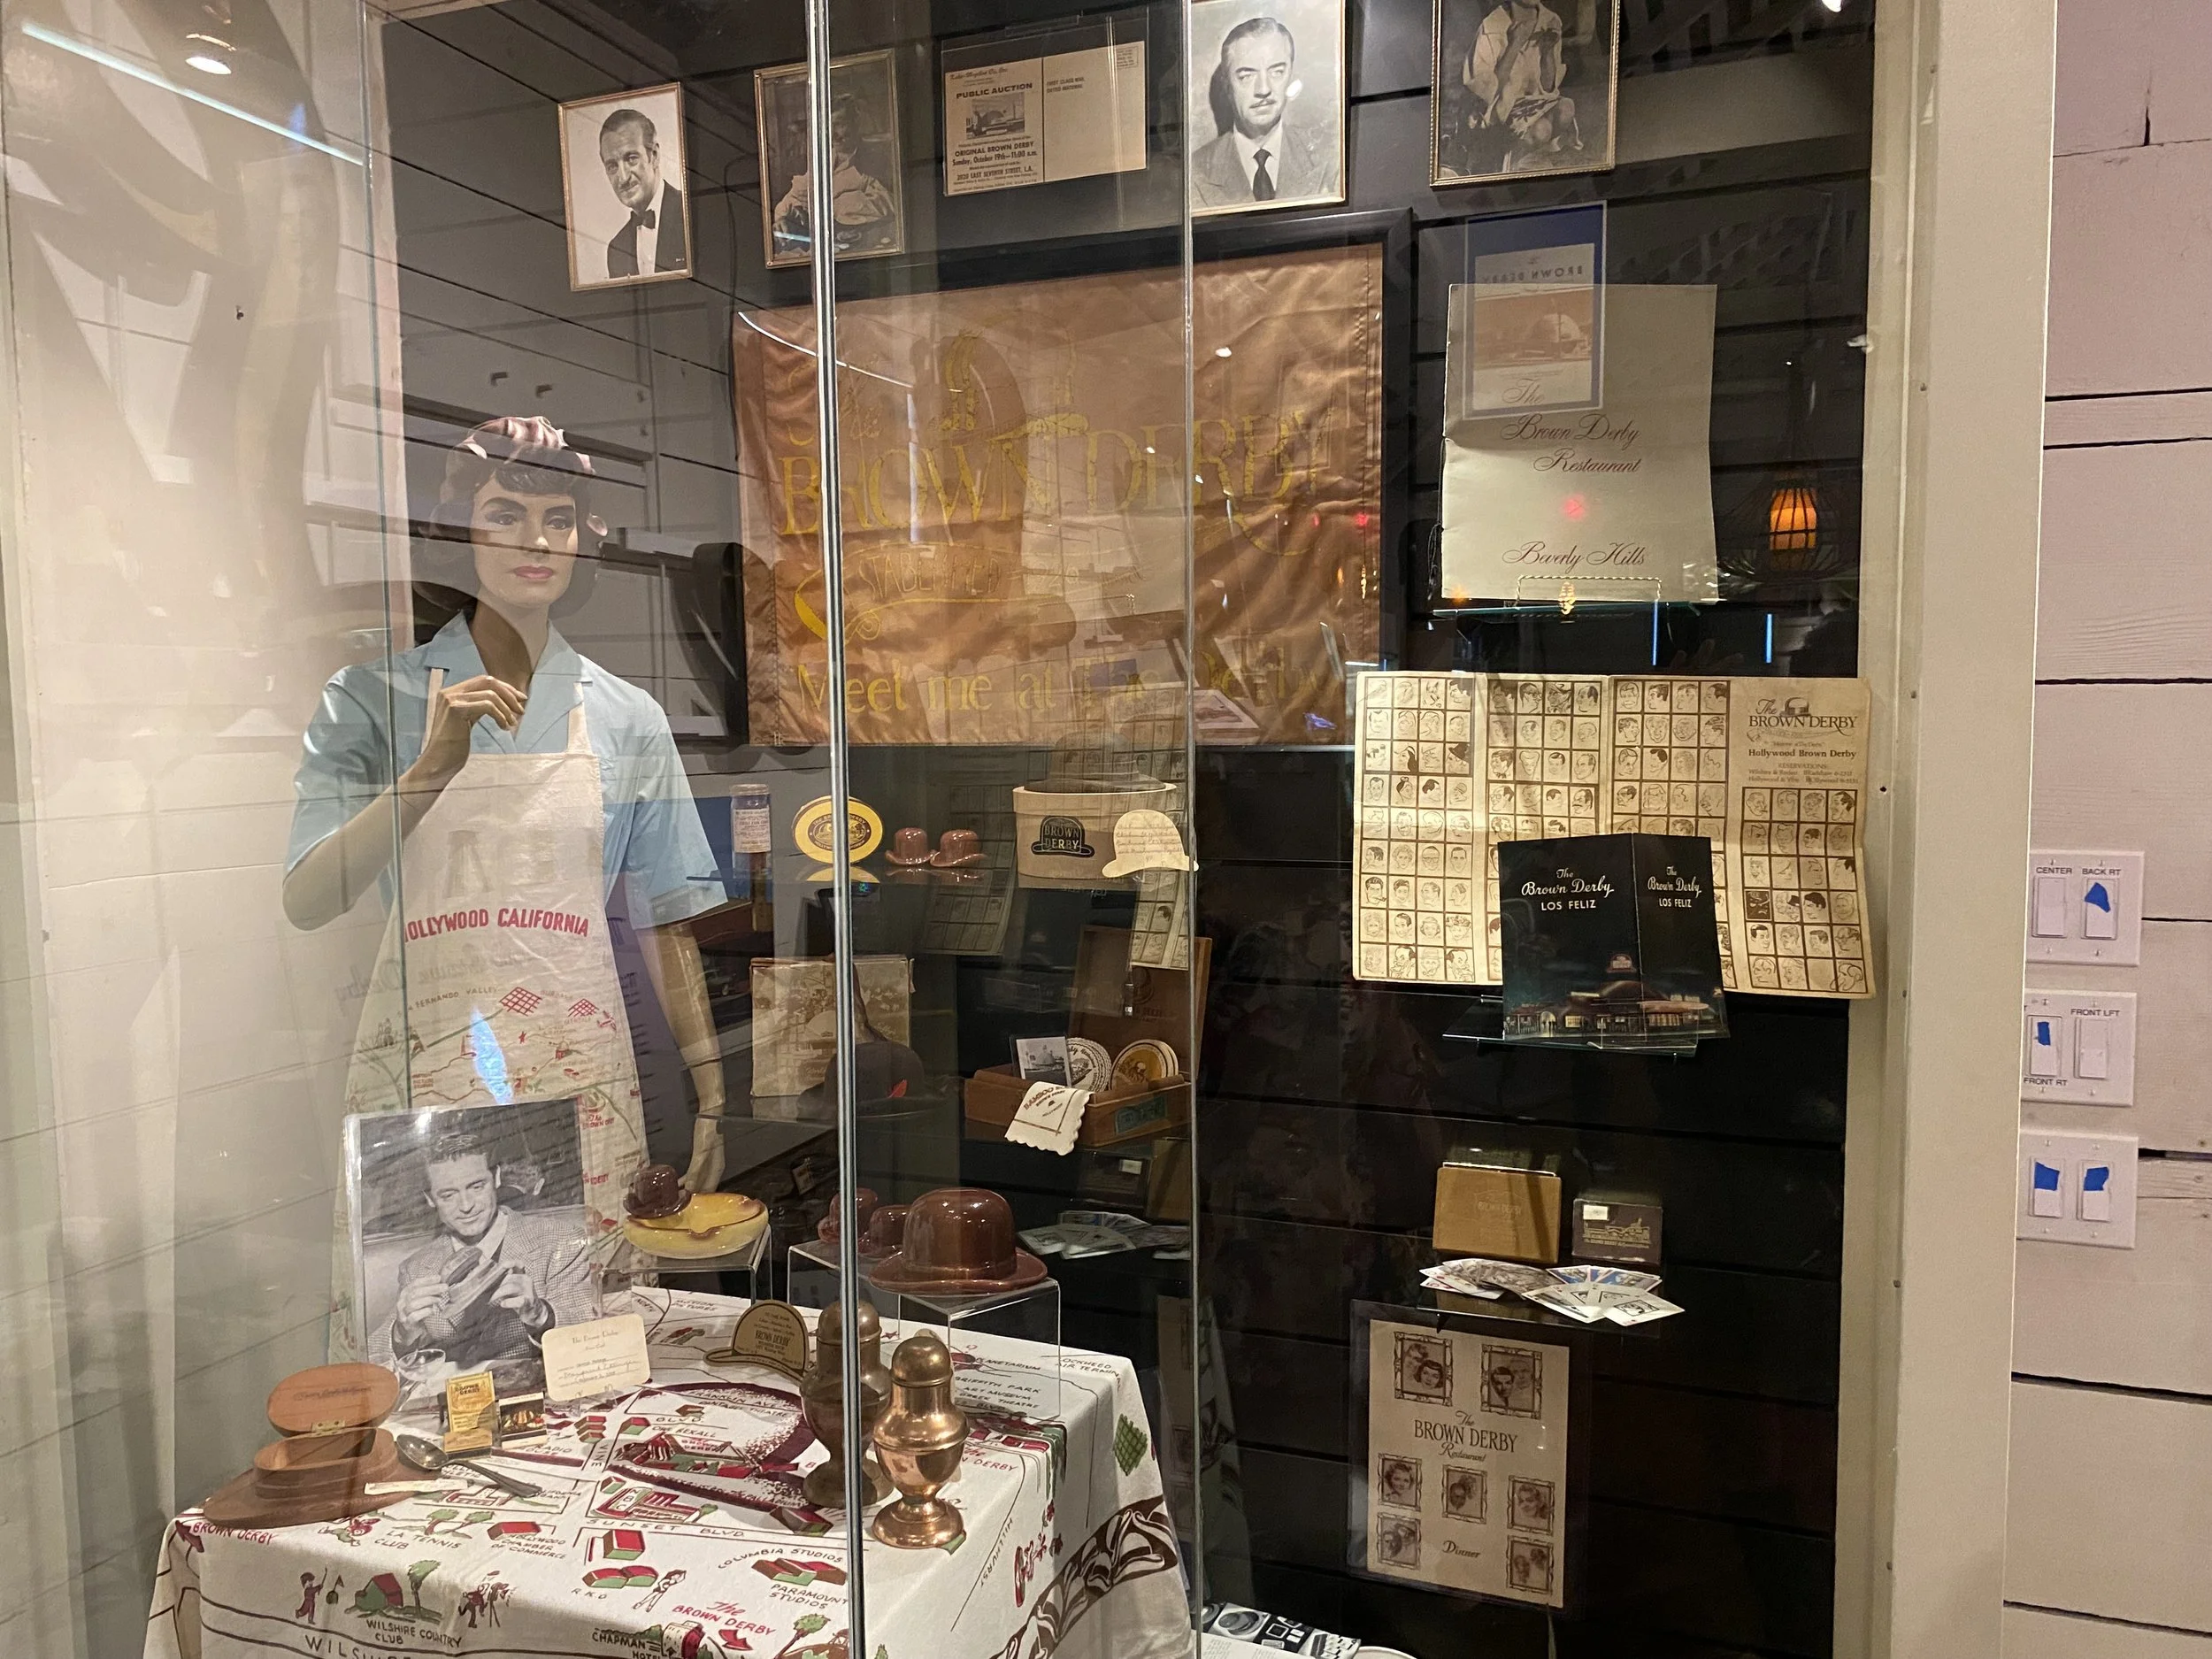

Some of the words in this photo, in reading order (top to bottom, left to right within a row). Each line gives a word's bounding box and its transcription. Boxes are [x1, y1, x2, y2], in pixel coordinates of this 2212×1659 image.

[956, 88, 989, 99] PUBLIC
[991, 82, 1033, 94] AUCTION
[955, 148, 986, 157] ORIGINAL
[987, 144, 1012, 153] BROWN
[1503, 379, 1544, 405] The
[1501, 413, 1571, 441] Brown
[1571, 413, 1640, 449] Derby
[1533, 448, 1642, 473] Restaurant
[1502, 541, 1585, 574] Beverly
[1586, 541, 1646, 566] Hills
[927, 673, 992, 711] me
[1018, 662, 1056, 711] at
[1755, 698, 1778, 715] The
[1748, 715, 1805, 727] BROWN
[1809, 716, 1858, 731] DERBY
[1748, 749, 1795, 759] Hollywood
[1830, 749, 1856, 760] Derby
[1044, 825, 1079, 839] BROWN
[1045, 838, 1079, 850] DERBY
[1555, 868, 1574, 879] The
[1666, 865, 1678, 876] The
[1521, 881, 1568, 896] Brown
[1571, 875, 1615, 898] Derby
[1647, 876, 1674, 891] Brown
[1675, 876, 1702, 898] Derby
[1540, 900, 1563, 911] LOS
[1568, 900, 1597, 910] FELIZ
[1658, 898, 1672, 908] LOS
[1674, 899, 1692, 908] FELIZ
[497, 908, 589, 938] CALIFORNIA
[415, 990, 459, 1010] FERNANDO
[755, 1330, 772, 1342] BROWN
[772, 1333, 791, 1347] DERBY
[975, 1357, 1041, 1371] PLANETARIUM
[1060, 1358, 1111, 1370] OCKHEED
[955, 1376, 1002, 1387] GRIFFITH
[1007, 1384, 1041, 1394] PARK
[688, 1391, 747, 1404] FRANKLIN
[987, 1390, 1031, 1401] MUSEUM
[998, 1399, 1041, 1409] THEATRE
[1455, 1410, 1476, 1426] The
[675, 1428, 716, 1438] REXALL
[1414, 1419, 1464, 1445] BROWN
[1470, 1428, 1518, 1453] DERBY
[1438, 1441, 1486, 1462] Restaurant
[973, 1459, 1018, 1471] DERBY
[587, 1518, 678, 1532] SUNSET
[191, 1522, 234, 1539] BROWN
[238, 1530, 279, 1545] DERBY
[387, 1530, 405, 1539] LA
[412, 1532, 462, 1549] TENNIS
[508, 1532, 566, 1546] HOLLYWOOD
[374, 1538, 410, 1549] CLUB
[502, 1540, 554, 1551] CHAMBER
[1442, 1540, 1482, 1559] Dinner
[509, 1547, 567, 1560] COMMERCE
[718, 1548, 784, 1570] COLUMBIA
[790, 1548, 843, 1563] STUDIOS
[769, 1593, 829, 1609] STUDIOS
[771, 1584, 849, 1605] PARAMOUNT
[706, 1601, 746, 1617] The
[672, 1604, 722, 1622] BROWN
[725, 1617, 777, 1636] DERBY
[366, 1619, 417, 1637] WILSHIRE
[419, 1628, 465, 1648] COUNTRY
[375, 1632, 404, 1645] CLUB
[592, 1632, 646, 1649] CHAPMAN
